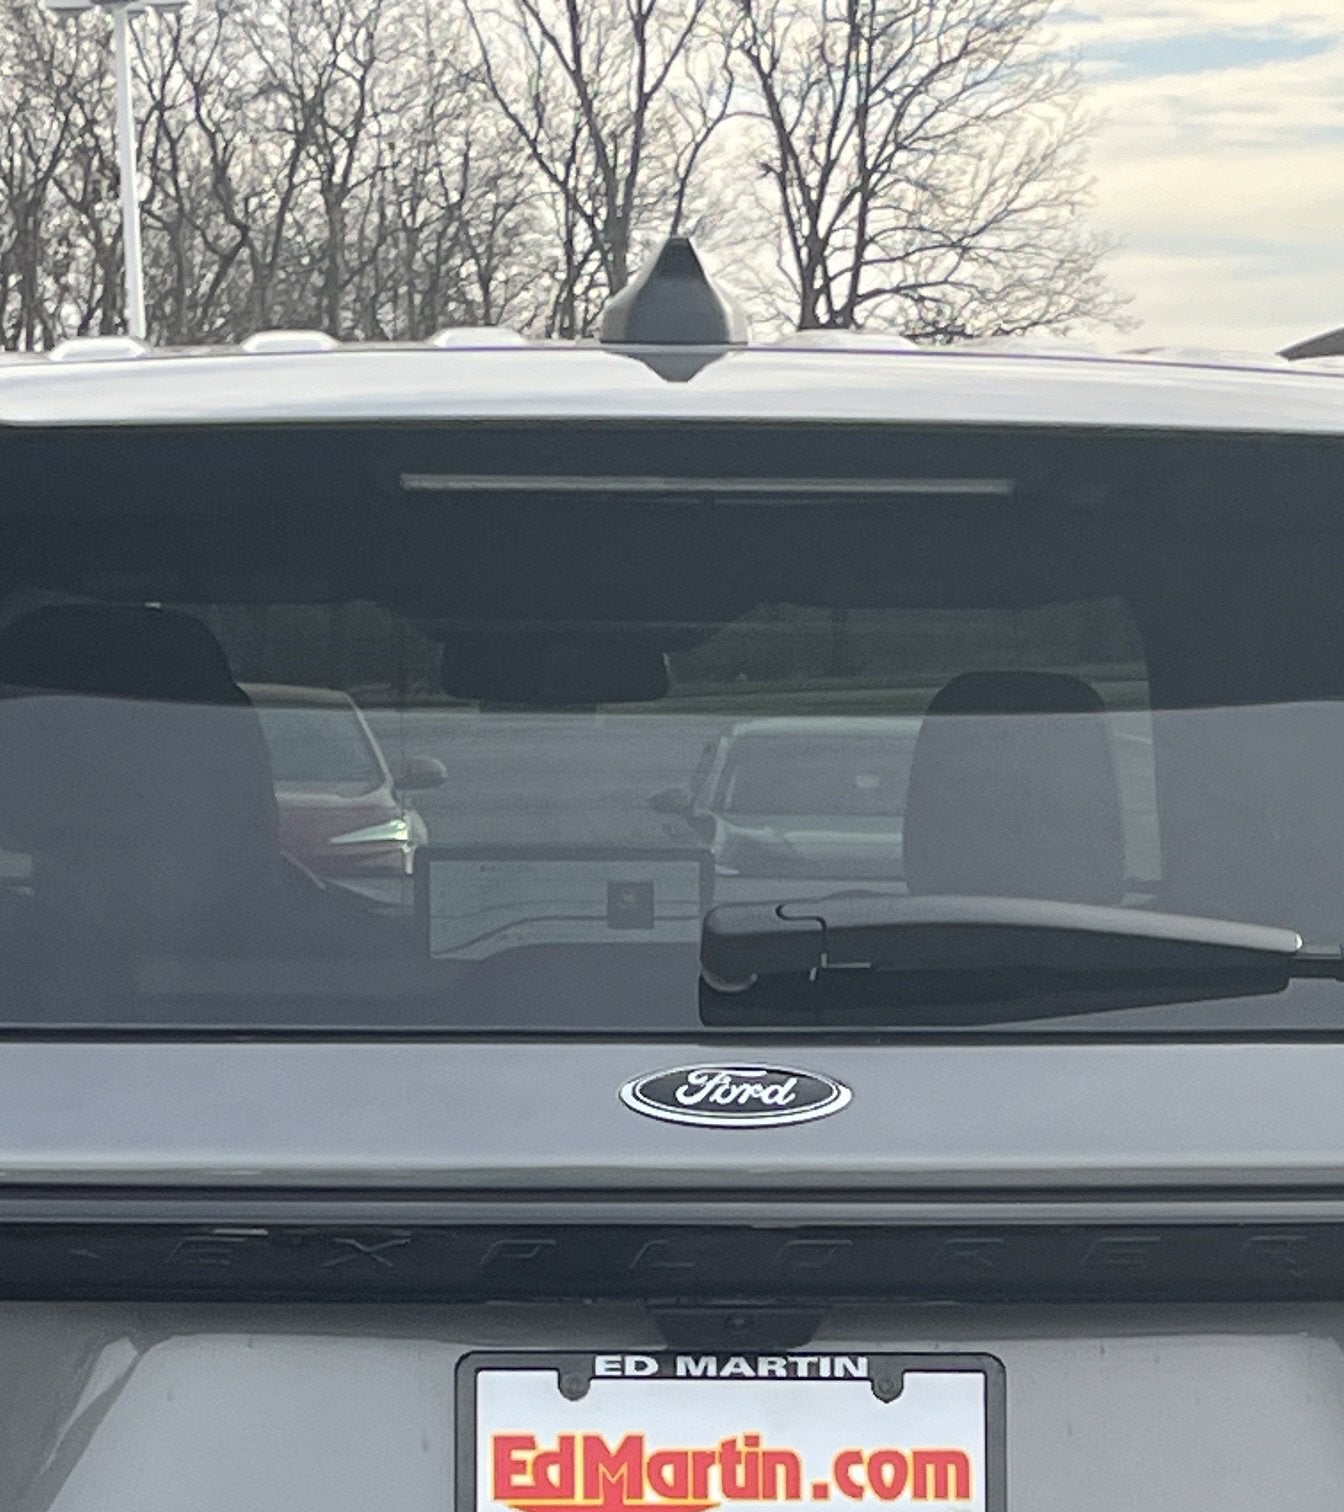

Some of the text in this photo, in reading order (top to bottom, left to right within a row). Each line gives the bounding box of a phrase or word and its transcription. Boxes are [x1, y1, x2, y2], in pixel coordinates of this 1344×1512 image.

[675, 1069, 798, 1105] Ford
[162, 1234, 1312, 1276] EXPLORER
[593, 1355, 870, 1378] ED MARTIN
[491, 1432, 972, 1506] EdMartin.com
